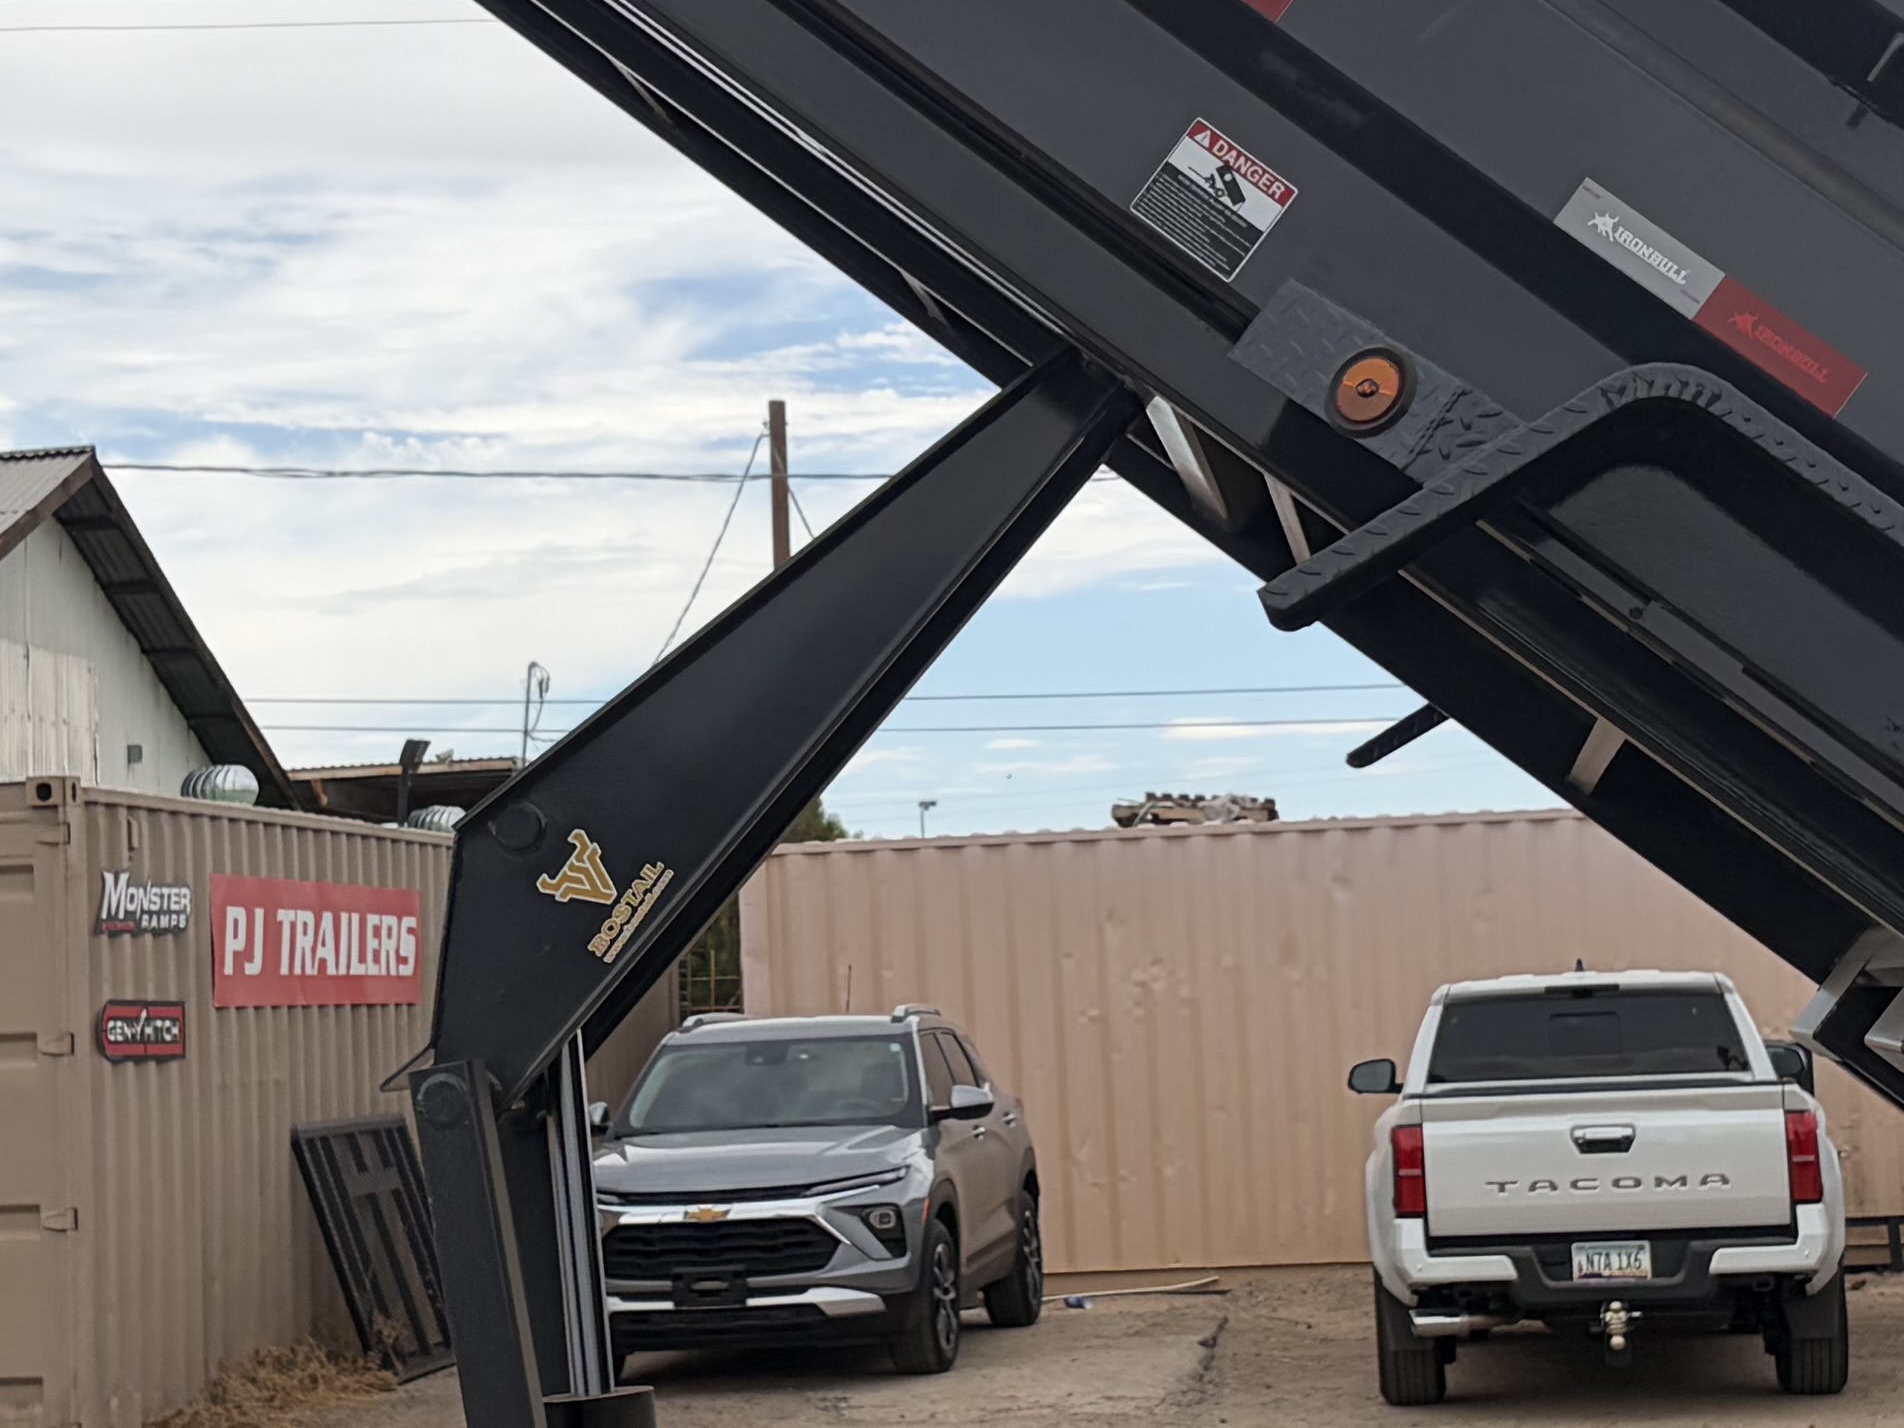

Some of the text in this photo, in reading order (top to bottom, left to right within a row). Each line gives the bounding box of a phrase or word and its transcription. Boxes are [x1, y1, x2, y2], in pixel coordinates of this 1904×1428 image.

[1212, 138, 1286, 200] DANGER
[1614, 225, 1688, 285] IRONBULL
[1754, 324, 1829, 383] IRONBULL
[100, 871, 191, 920] MONSTER
[141, 914, 186, 929] RAMPS
[588, 862, 664, 957] BOSTAIL
[223, 905, 418, 977] PJ TRAILERS
[1485, 1173, 1730, 1194] TACOMA
